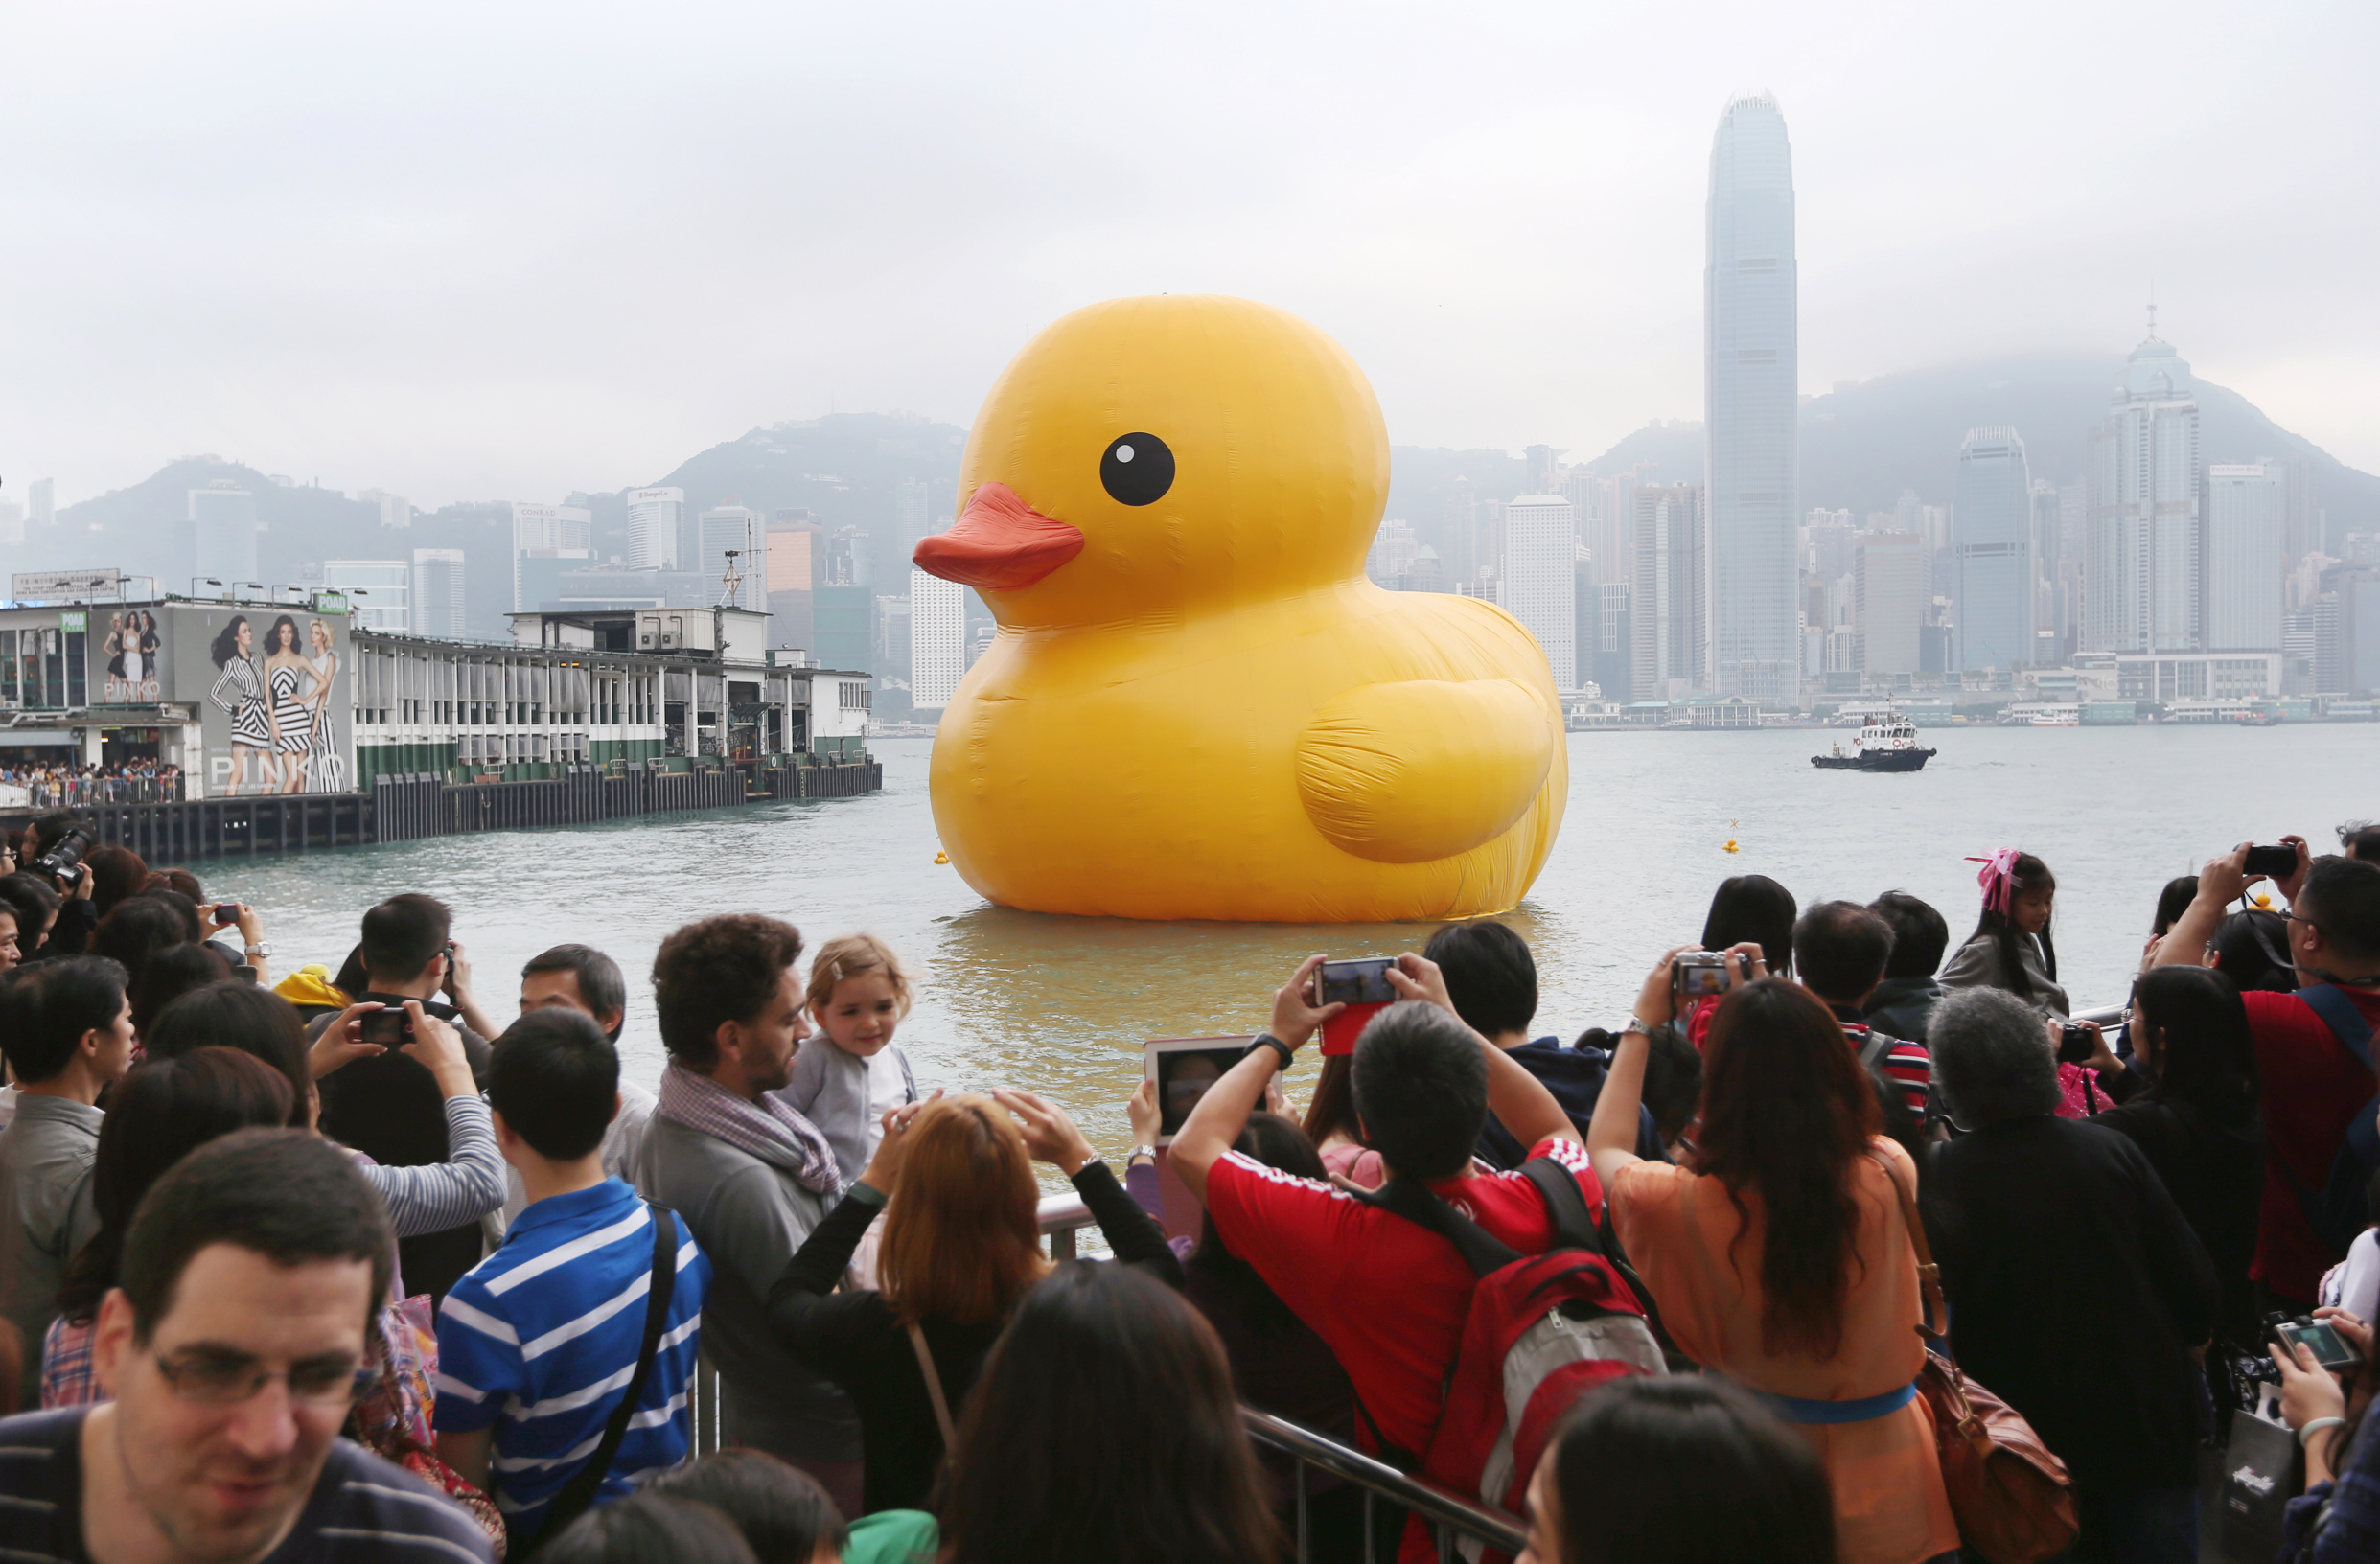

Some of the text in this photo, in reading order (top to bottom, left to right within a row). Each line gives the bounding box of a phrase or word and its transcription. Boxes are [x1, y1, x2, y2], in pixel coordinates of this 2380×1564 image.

[521, 508, 556, 517] CONRAD
[319, 596, 346, 609] POAD
[62, 613, 84, 626] POAD
[104, 681, 161, 696] PINKO
[211, 754, 345, 784] PINKO
